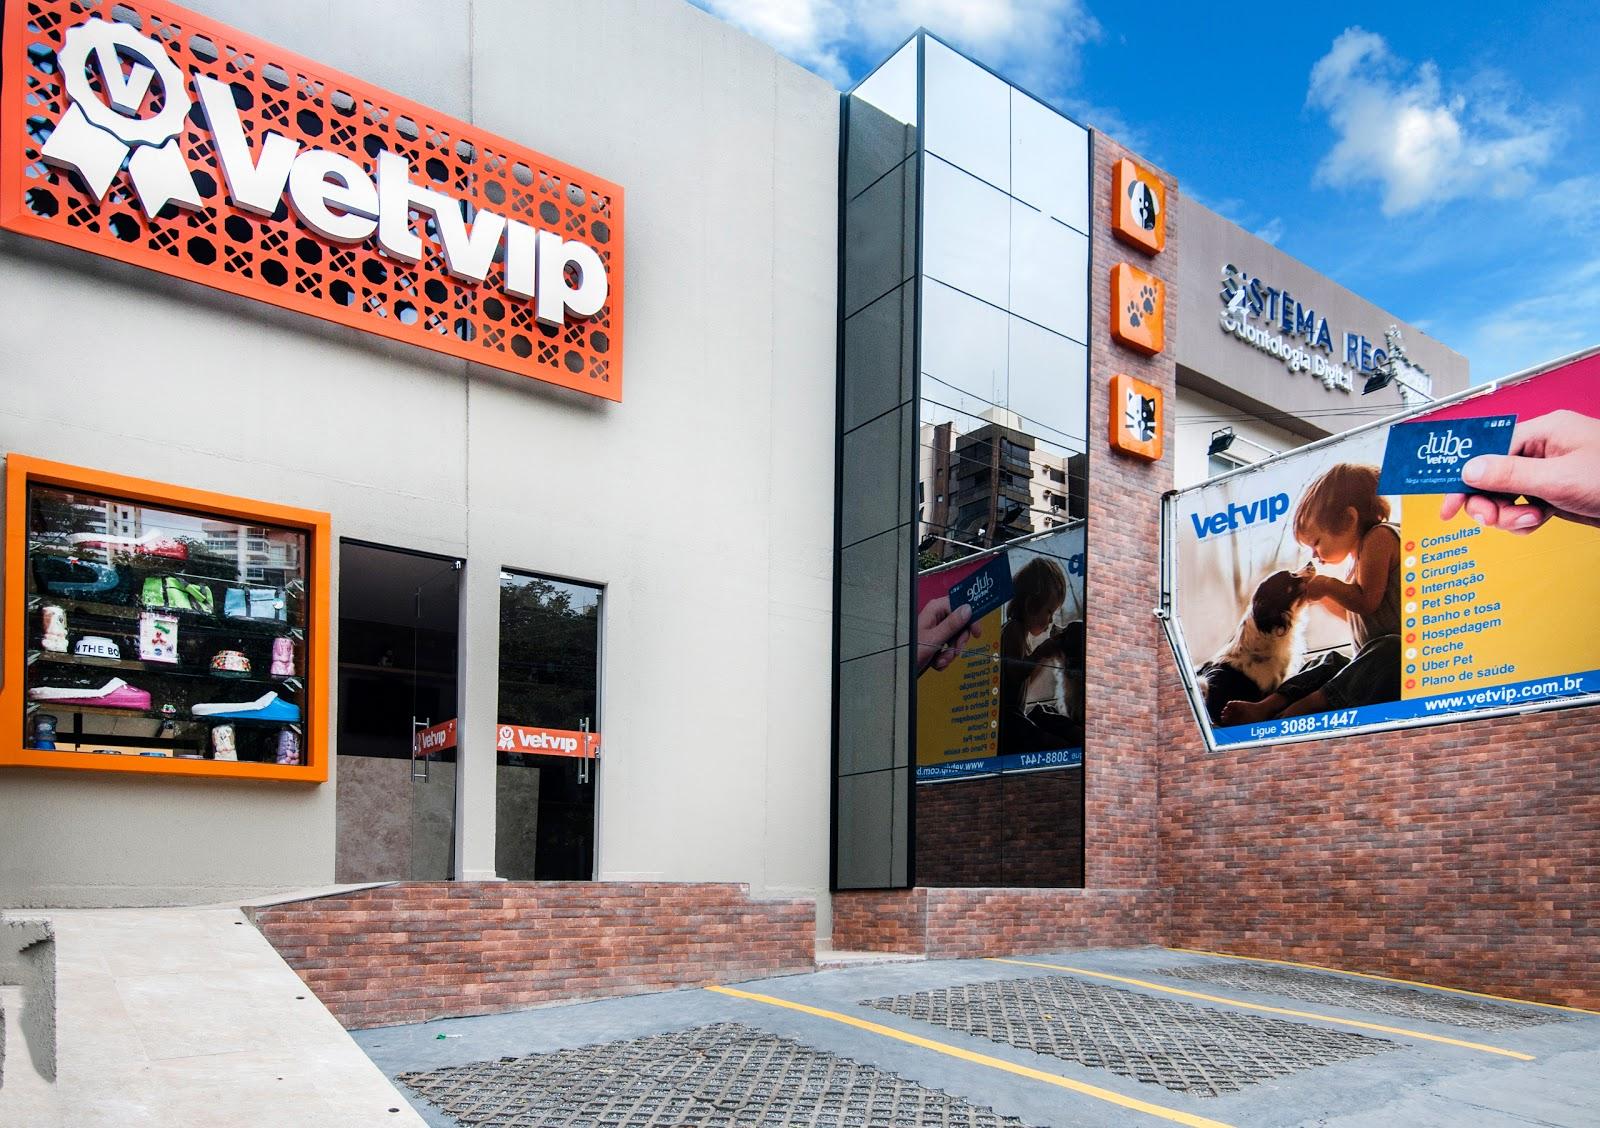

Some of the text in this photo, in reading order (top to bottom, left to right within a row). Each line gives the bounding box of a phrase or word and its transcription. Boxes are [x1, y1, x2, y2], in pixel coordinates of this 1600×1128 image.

[1311, 354, 1354, 392] Digital
[1421, 526, 1481, 549] Consultas
[1421, 546, 1468, 564] Exames
[1421, 560, 1476, 580] Cirurgias
[1421, 573, 1485, 594] Internação
[1422, 591, 1476, 609] Pet Shop
[1422, 602, 1501, 625] Banho e tosa
[1422, 618, 1502, 640] Hospedagem
[82, 644, 104, 654] THE
[1422, 642, 1464, 656] Creche
[1422, 654, 1473, 672] Uber Pet
[1422, 663, 1515, 687] Plano de saúde
[1425, 676, 1584, 711] www.vetvip.com.br
[1250, 710, 1358, 739] Ligue 3088-1447
